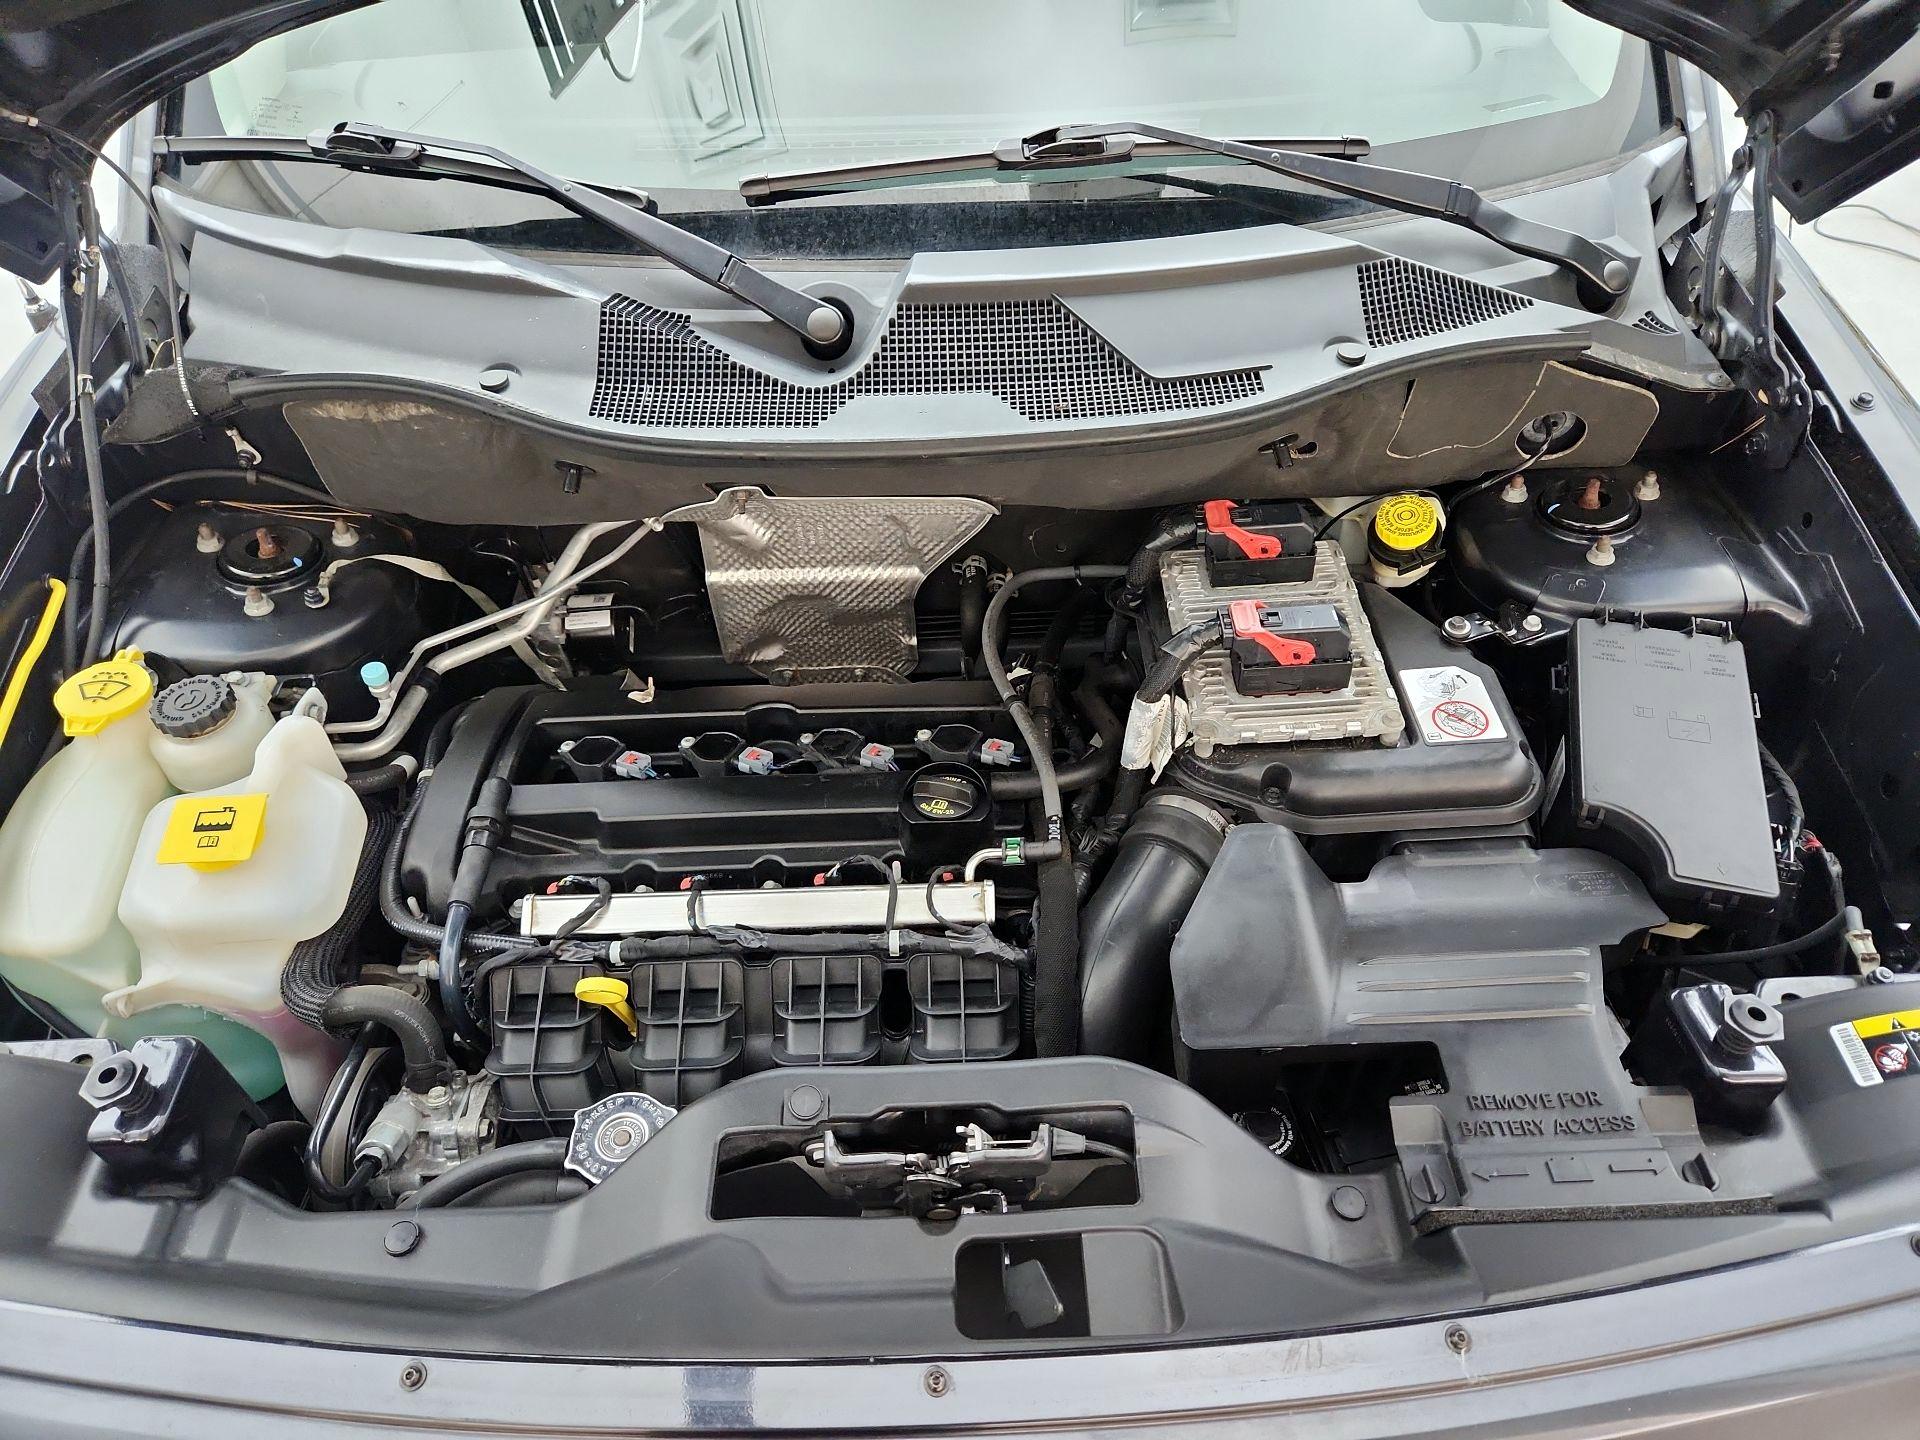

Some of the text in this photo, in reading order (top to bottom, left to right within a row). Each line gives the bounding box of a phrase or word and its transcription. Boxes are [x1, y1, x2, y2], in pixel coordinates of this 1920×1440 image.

[590, 1098, 625, 1120] KEEP
[632, 1096, 662, 1117] TIGHT
[1466, 1090, 1603, 1111] REMOVE FOR
[1458, 1115, 1637, 1138] BATTERY ACCESS
